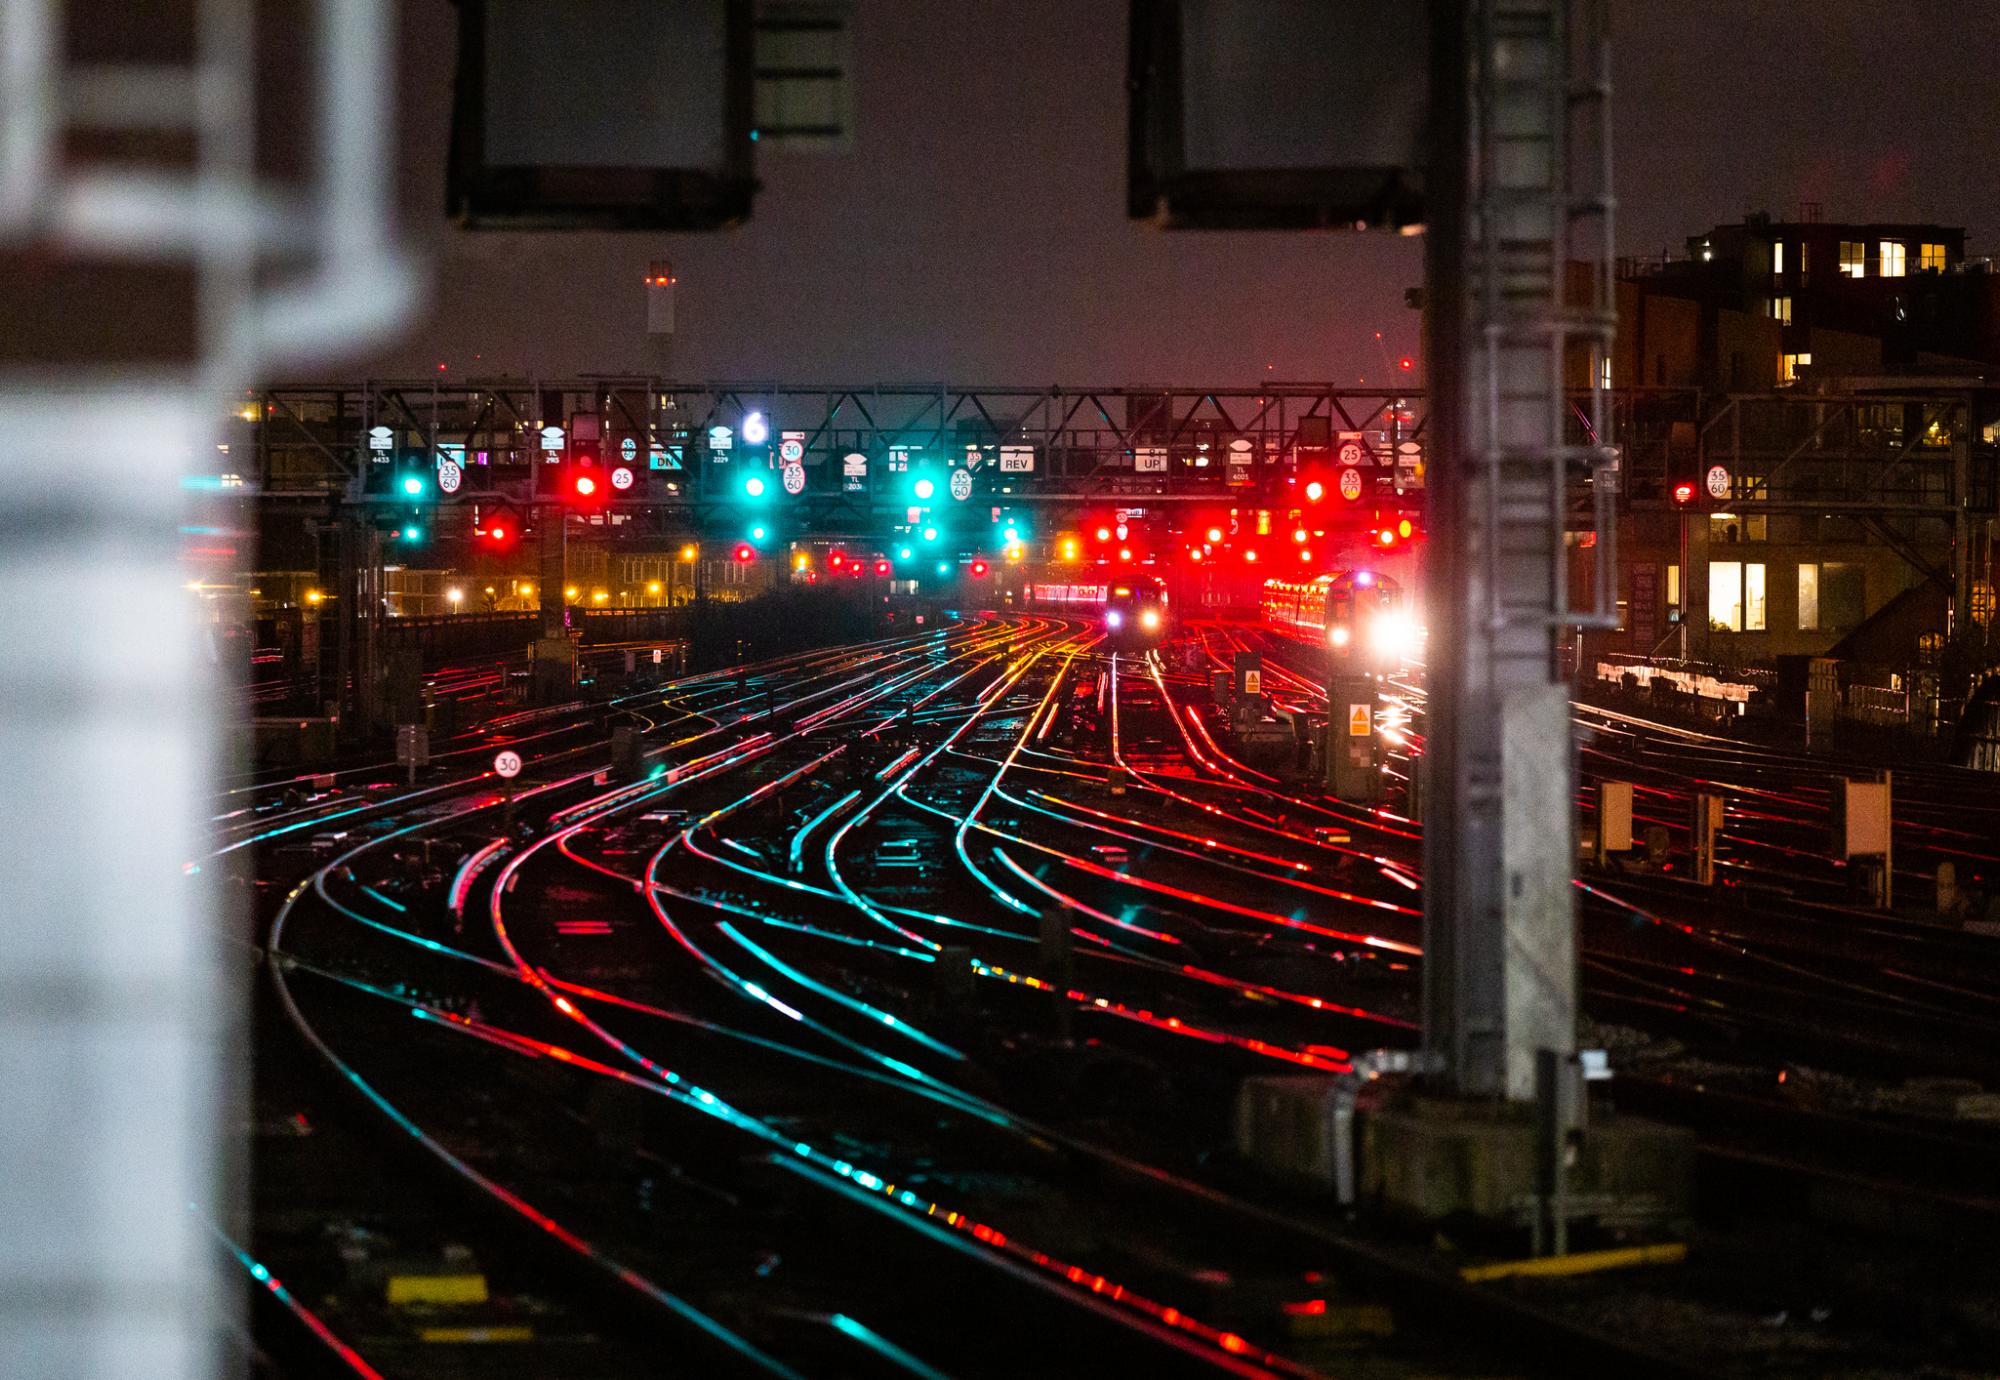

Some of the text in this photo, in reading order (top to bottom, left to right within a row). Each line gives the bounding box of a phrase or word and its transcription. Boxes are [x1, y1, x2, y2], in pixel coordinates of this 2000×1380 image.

[743, 412, 765, 443] 6
[785, 445, 799, 456] 30
[1344, 449, 1358, 460] 25
[658, 458, 674, 467] DN
[1005, 459, 1028, 469] REV
[1144, 459, 1160, 469] UP
[443, 465, 457, 476] 35
[787, 466, 801, 477] 35
[1711, 470, 1725, 481] 35
[615, 473, 630, 484] 25
[954, 473, 968, 484] 35
[1344, 472, 1358, 483] 35
[443, 479, 457, 488] 60
[787, 480, 801, 490] 60
[1711, 483, 1725, 494] 60
[954, 486, 968, 497] 60
[1343, 485, 1358, 496] 60
[500, 758, 517, 771] 30
